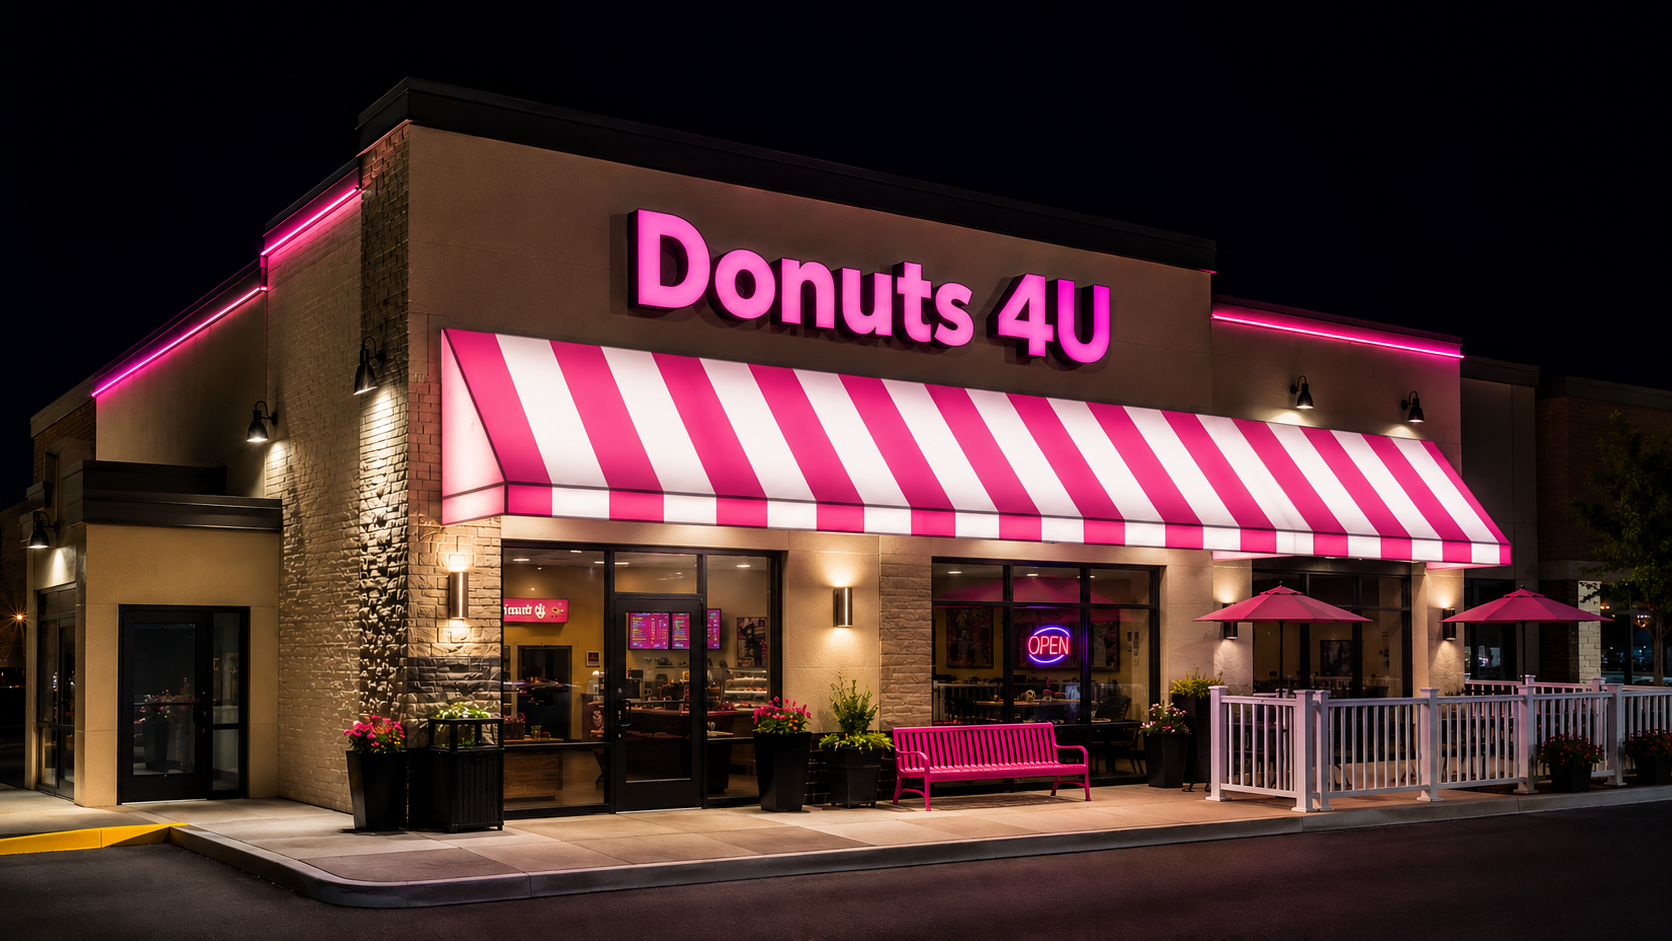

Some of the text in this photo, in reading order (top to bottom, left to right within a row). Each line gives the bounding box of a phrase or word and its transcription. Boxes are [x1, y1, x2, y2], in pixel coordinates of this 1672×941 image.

[635, 208, 1112, 365] Donuts 4U
[1028, 635, 1069, 655] OPEN
